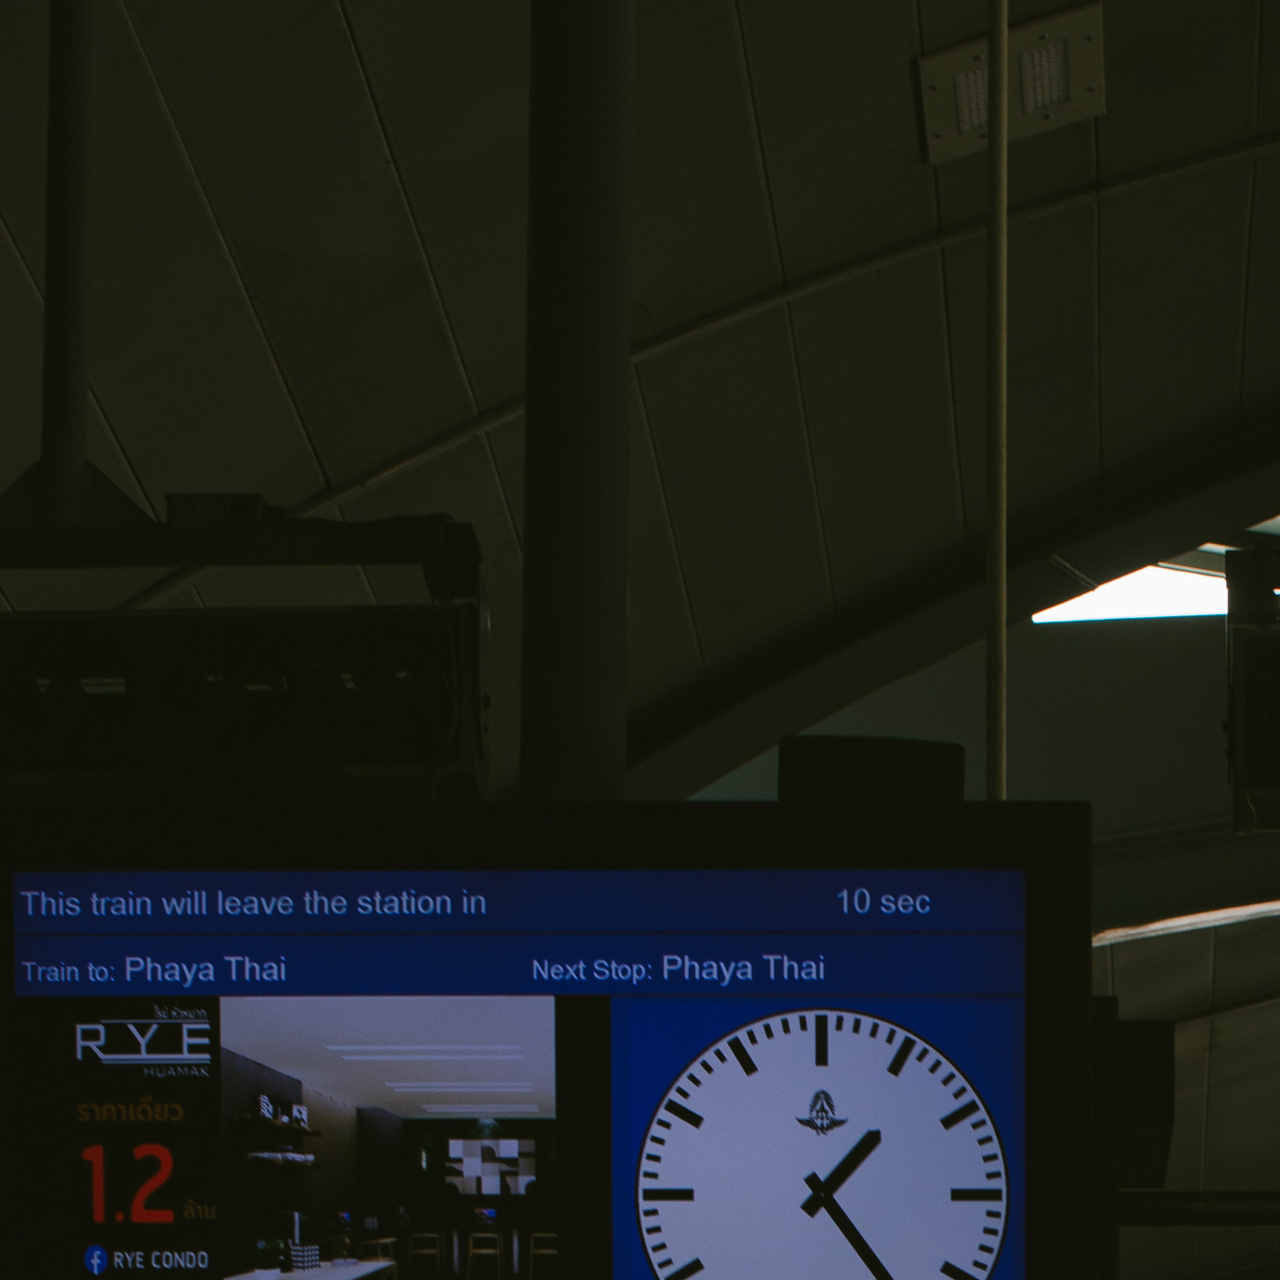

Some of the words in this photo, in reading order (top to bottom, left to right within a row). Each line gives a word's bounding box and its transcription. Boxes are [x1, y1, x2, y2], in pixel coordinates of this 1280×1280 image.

[20, 891, 82, 916] This
[90, 890, 152, 916] train
[162, 890, 207, 916] will
[218, 890, 294, 916] leave
[304, 890, 348, 915] the
[356, 889, 452, 915] station
[462, 889, 487, 915] in
[837, 888, 871, 914] 10
[880, 894, 931, 914] sec
[22, 961, 80, 982] Train
[87, 962, 115, 982] to:
[125, 956, 215, 989] Phaya
[223, 955, 286, 982] Thai
[532, 959, 587, 981] Next
[592, 959, 652, 986] Stop:
[662, 954, 753, 987] Phaya
[762, 954, 825, 981] Thai
[75, 1022, 212, 1062] RYE
[143, 1066, 210, 1078] HUAMAK
[77, 1094, 184, 1122] ราคาเดียว
[81, 1142, 175, 1224] 1.2
[182, 1199, 217, 1220] ล้าน
[113, 1251, 145, 1269] RYE
[151, 1250, 209, 1269] CONDO
